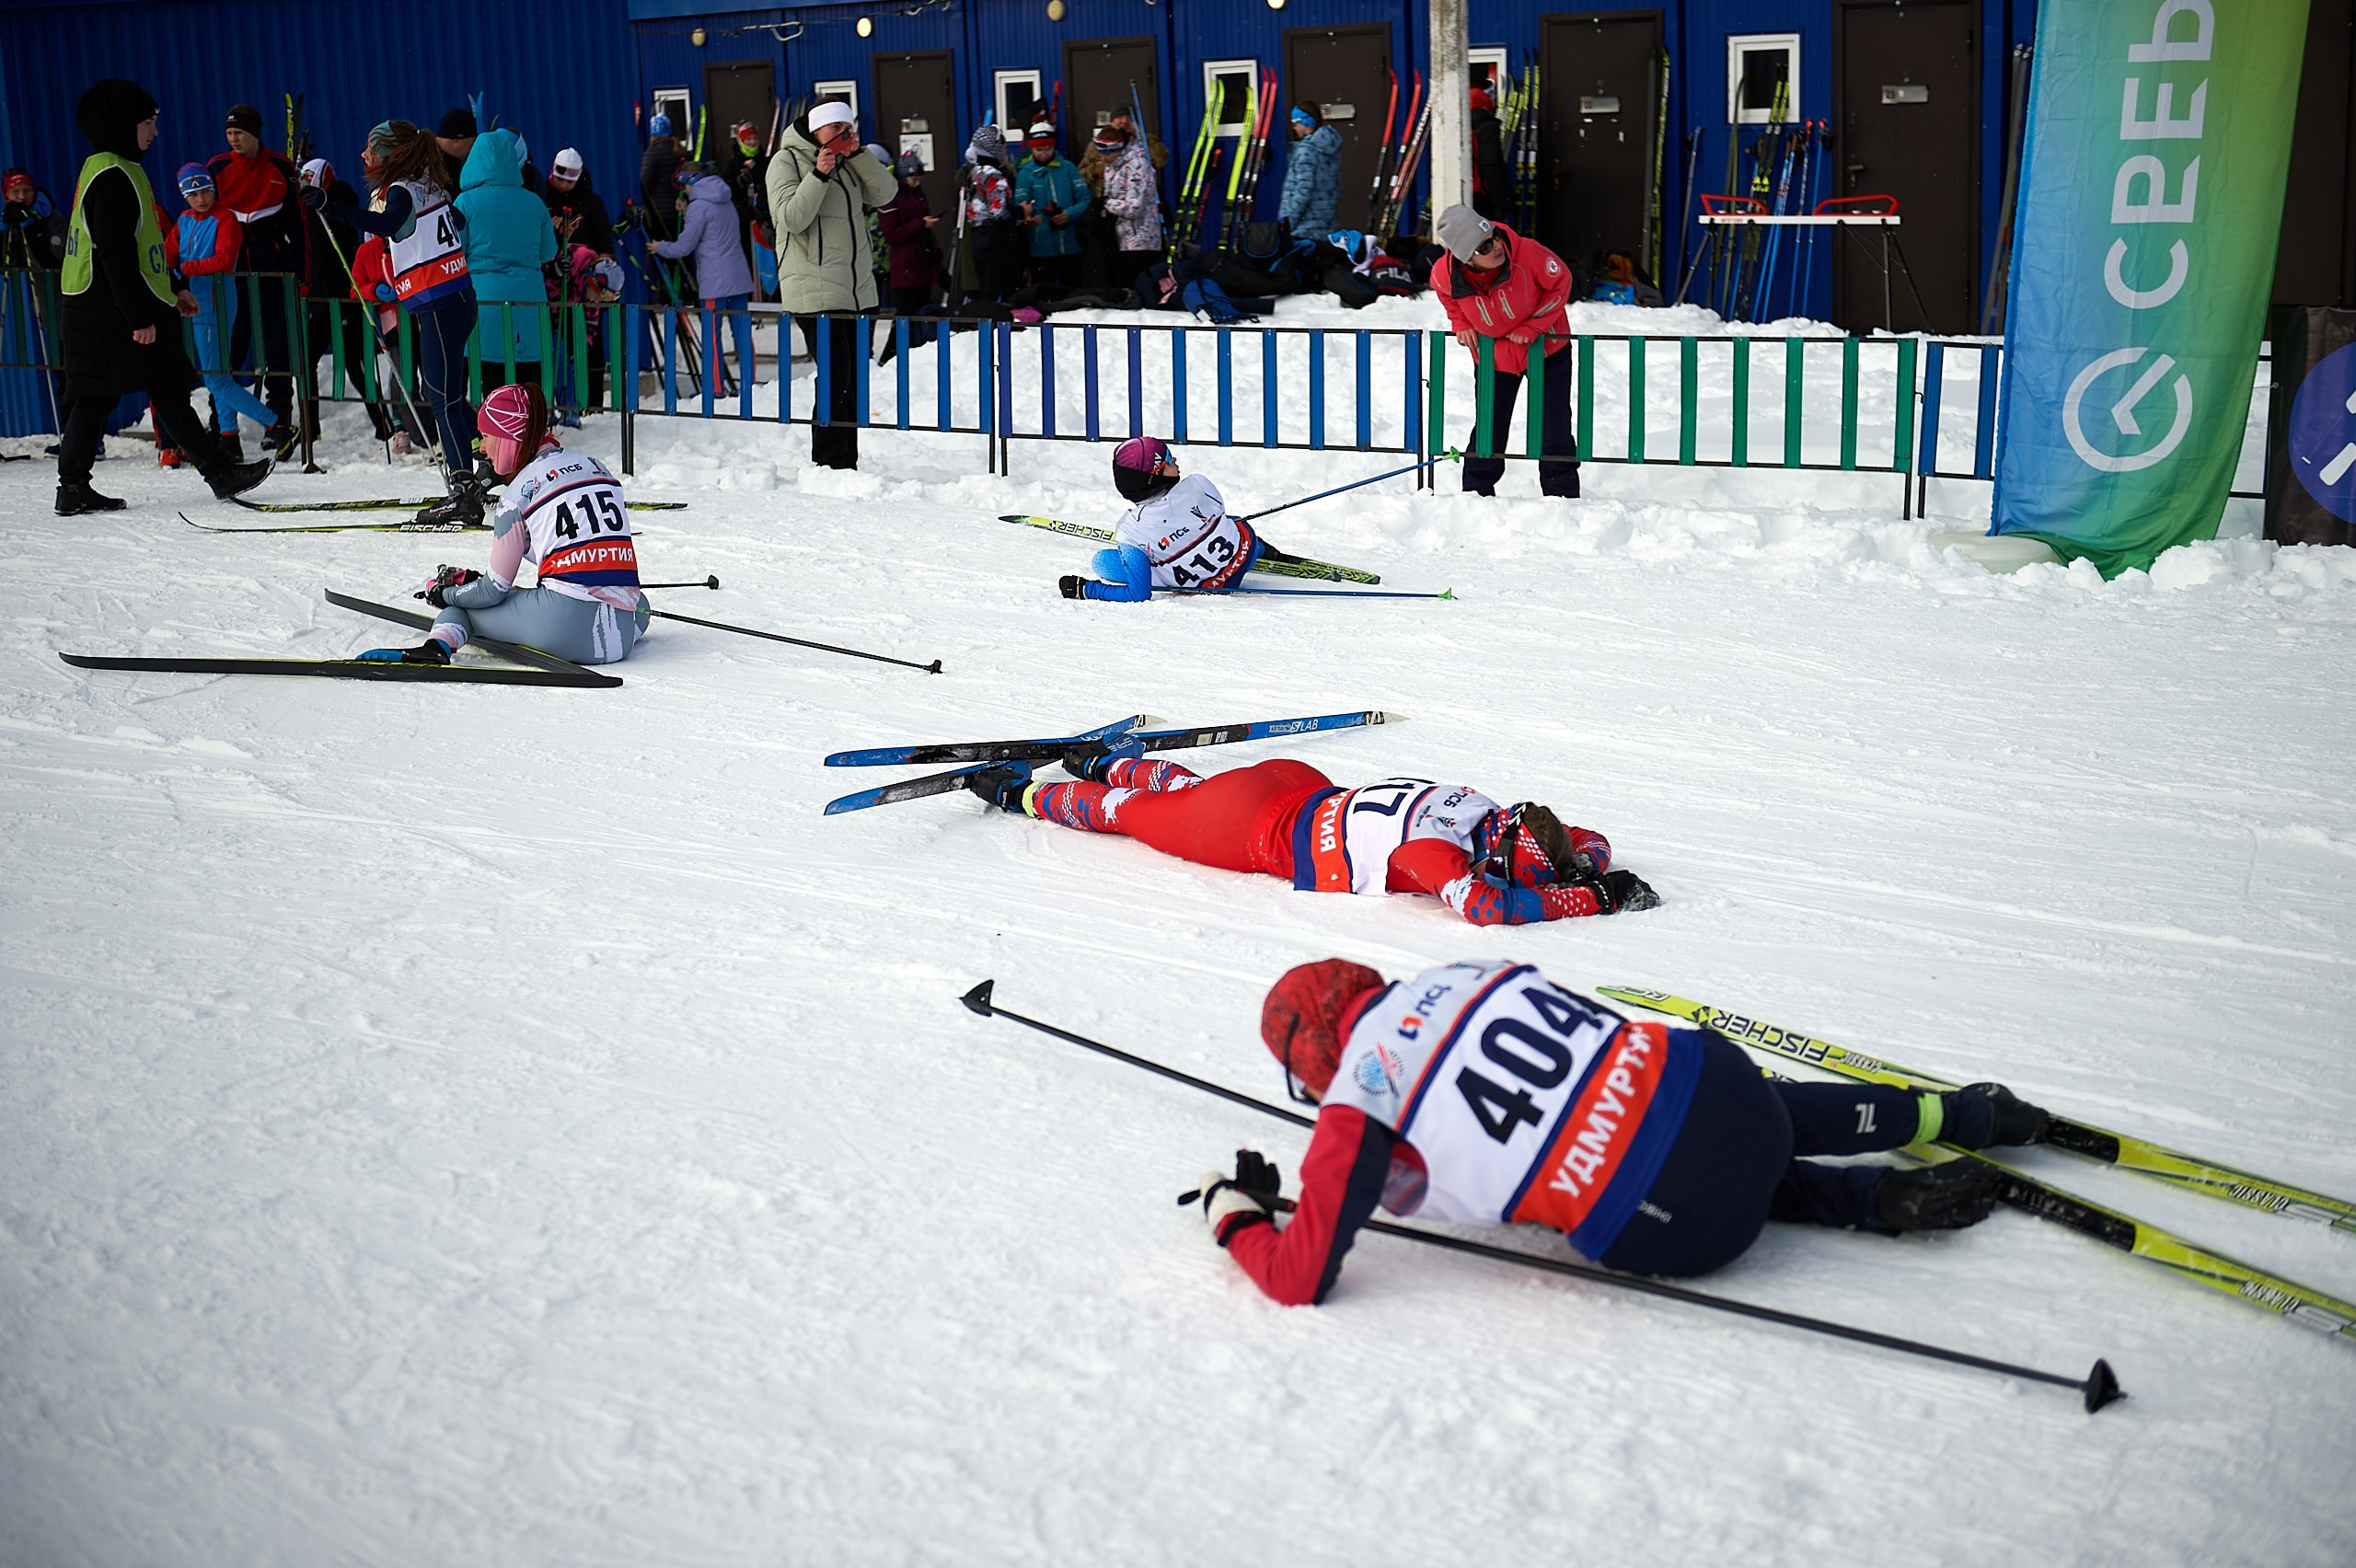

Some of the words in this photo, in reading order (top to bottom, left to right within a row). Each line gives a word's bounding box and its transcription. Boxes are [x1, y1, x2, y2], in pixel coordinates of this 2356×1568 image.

[558, 463, 583, 475] ПСБ
[555, 490, 624, 540] 415
[1057, 521, 1114, 541] FISCHER
[1169, 526, 1190, 542] ПСБ
[1172, 536, 1235, 586] 413
[1353, 778, 1437, 816] 17
[1711, 1009, 1831, 1063] FISCHER
[1456, 986, 1605, 1145] 404
[1840, 1052, 1884, 1074] CLASSIC
[2228, 1182, 2292, 1212] CLASSIC
[2240, 1280, 2302, 1313] CLASSIC
